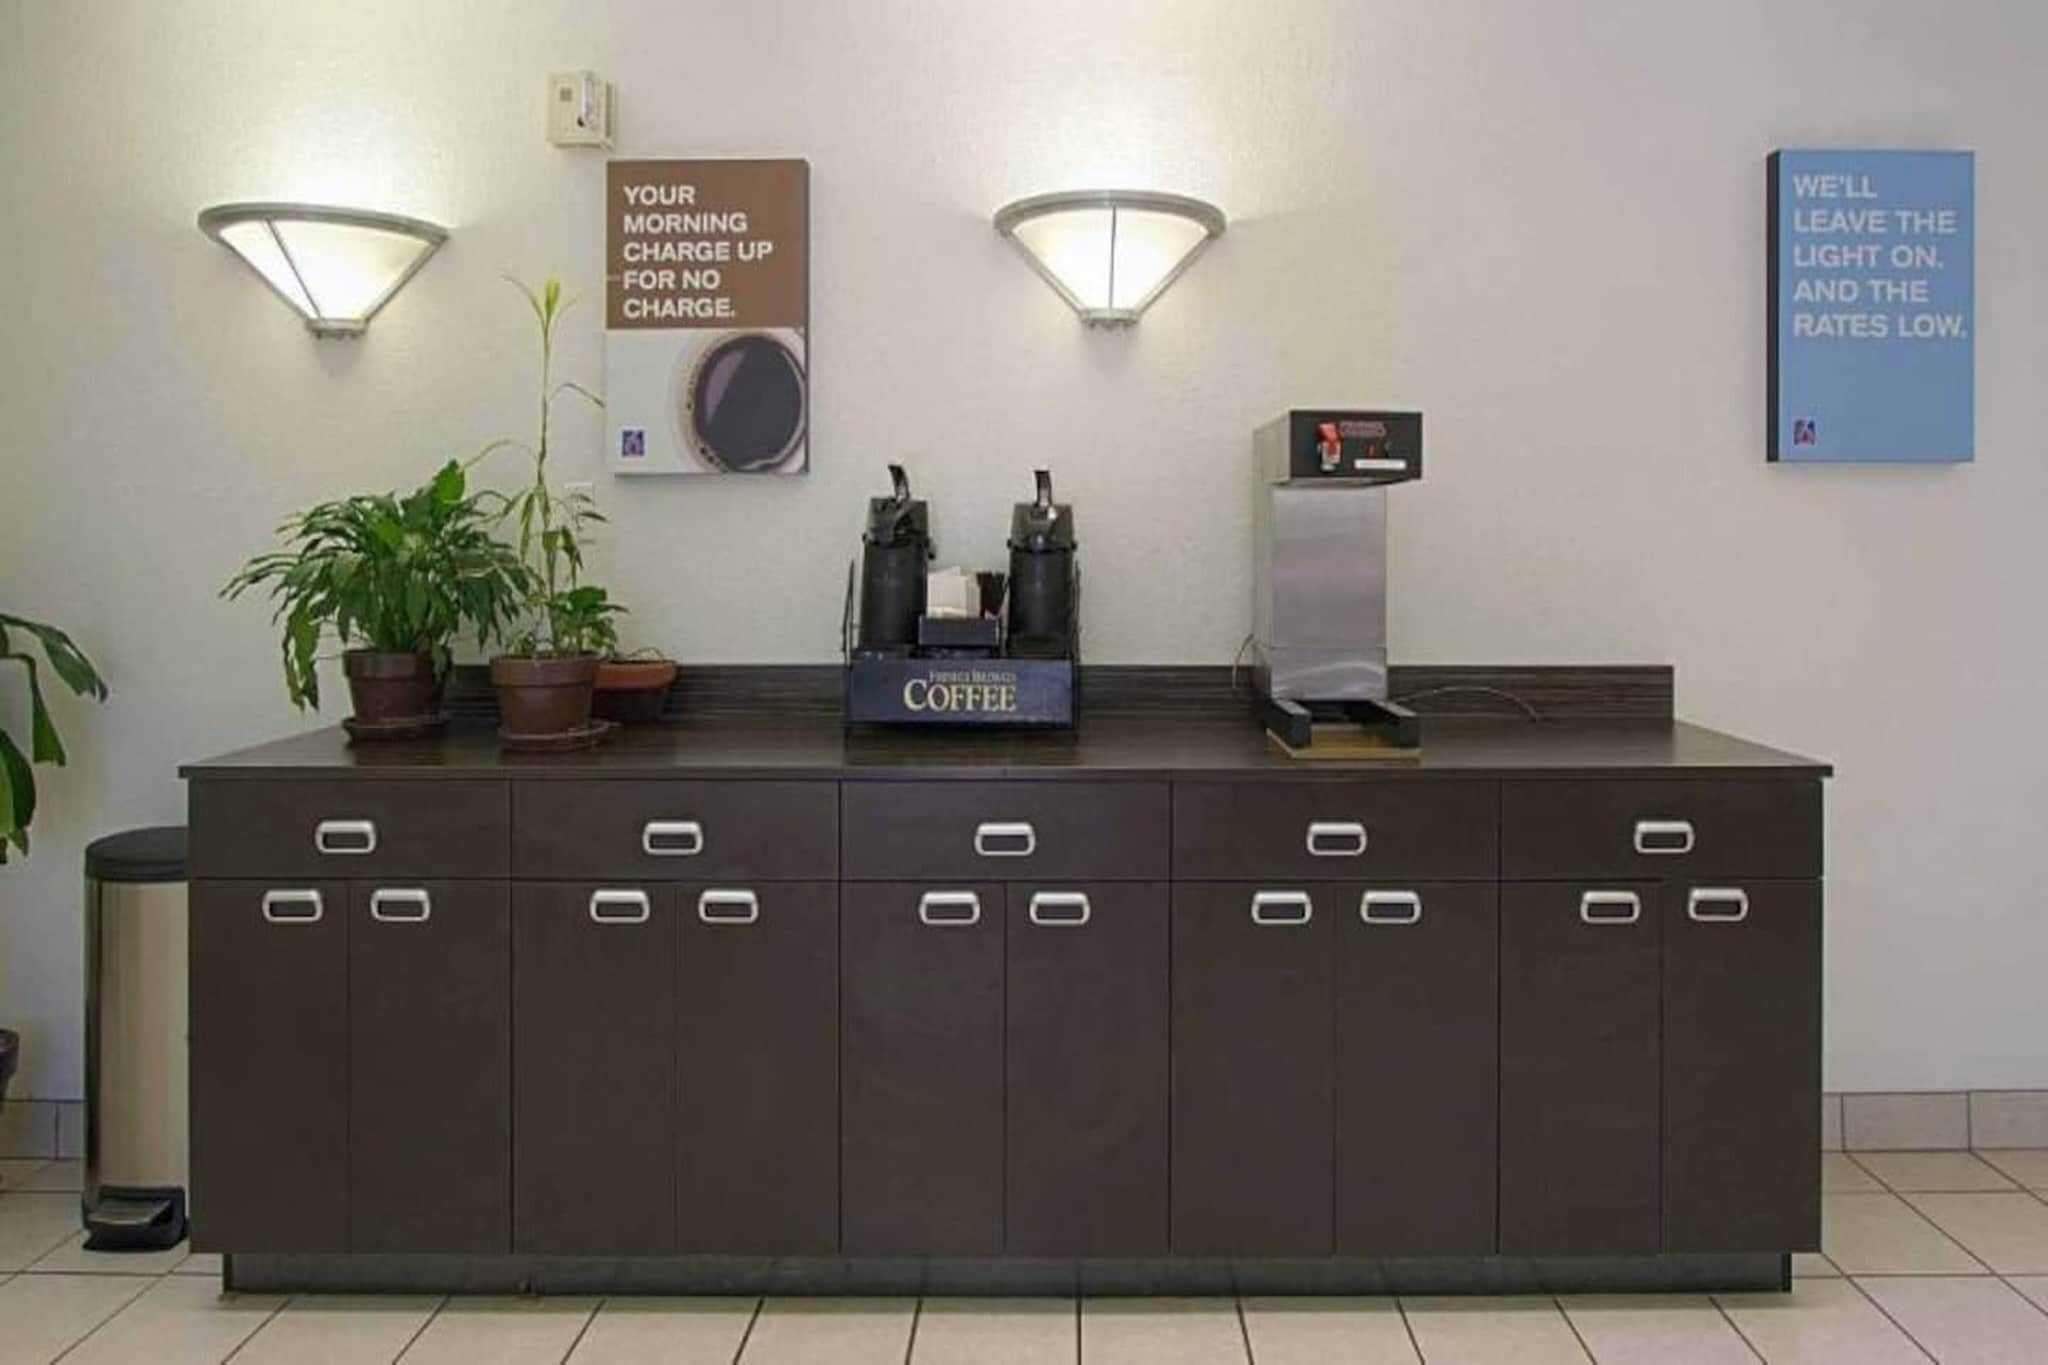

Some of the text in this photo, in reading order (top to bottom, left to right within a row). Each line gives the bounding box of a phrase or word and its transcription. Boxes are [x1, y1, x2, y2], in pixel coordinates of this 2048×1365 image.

[624, 185, 695, 205] YOUR
[1794, 175, 1877, 198] WE'LL
[624, 213, 747, 234] MORNING
[1794, 210, 1957, 233] LEAVE THE
[624, 241, 773, 262] CHARGE UP
[1794, 245, 1943, 268] LIGHT ON.
[624, 270, 720, 289] FOR NO
[1794, 280, 1928, 301] AND THE
[623, 298, 735, 318] CHARGE.
[1794, 314, 1967, 338] RATES LOW.
[904, 679, 1016, 711] COFFEE
